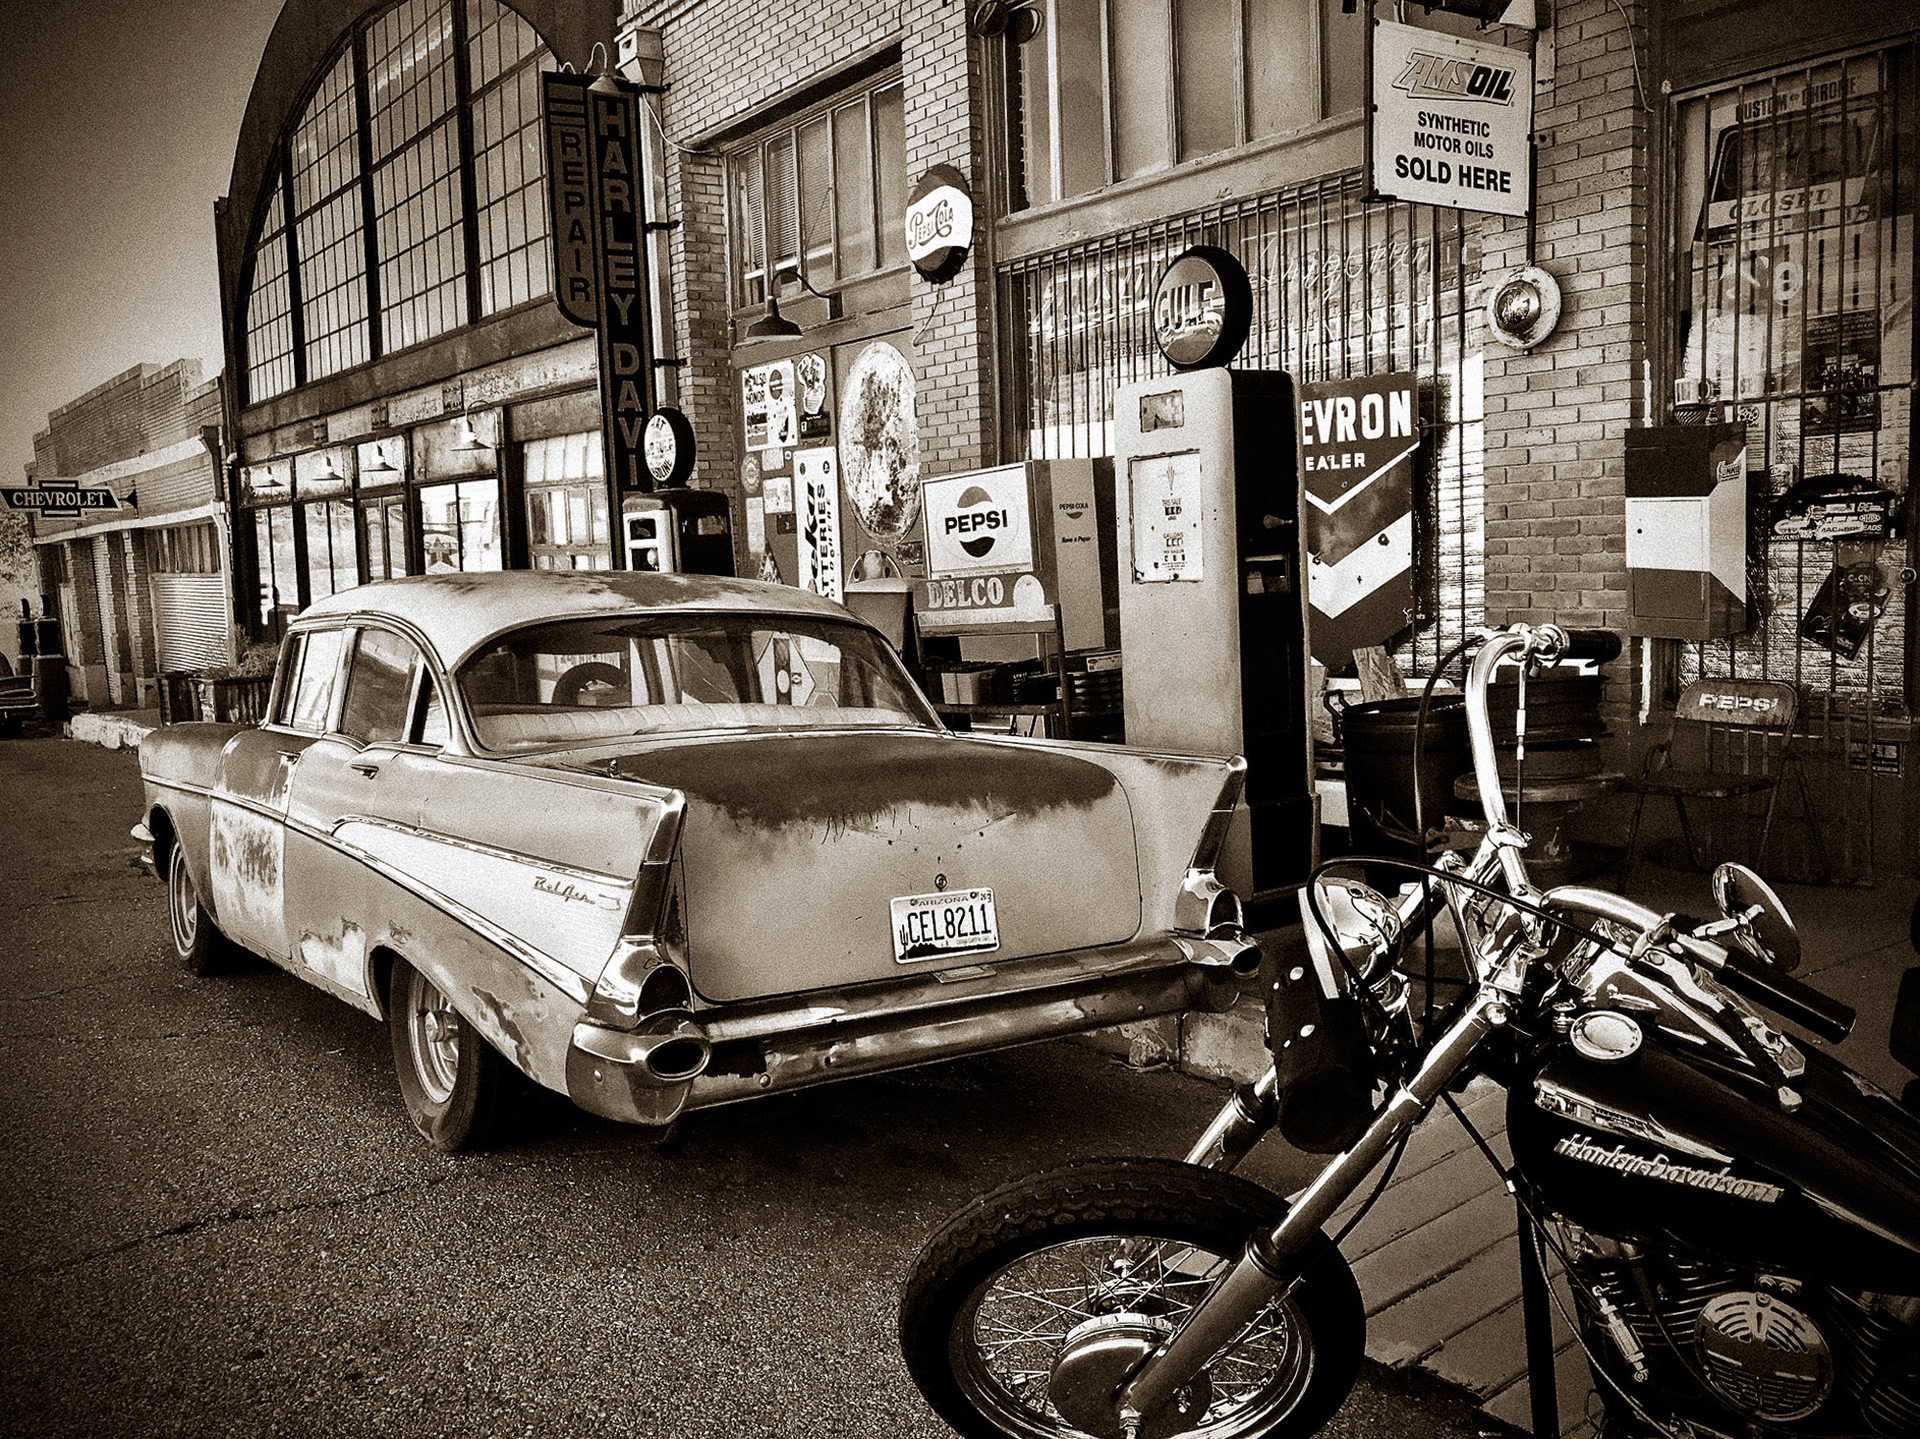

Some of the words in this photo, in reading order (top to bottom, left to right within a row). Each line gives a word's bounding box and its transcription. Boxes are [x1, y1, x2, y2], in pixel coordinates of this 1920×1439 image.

[1396, 50, 1515, 104] AMSOIL
[1802, 78, 1857, 106] CHROE
[1417, 111, 1491, 138] SYNTHETIC
[1414, 131, 1462, 154] MOTOR
[1465, 140, 1494, 159] OILS
[1395, 154, 1451, 184] SOLD
[1458, 164, 1512, 194] HERE
[560, 131, 591, 302] REPAIR
[597, 100, 637, 326] HARLEY
[1729, 188, 1834, 220] CLOSED
[612, 342, 644, 498] DAVI
[1301, 389, 1413, 446] EVRON
[1305, 453, 1366, 471] EALER
[12, 491, 107, 506] CHEVROLET
[945, 509, 1008, 535] PEPSI
[816, 483, 830, 598] TTERIES
[926, 577, 1005, 609] DELCO
[1699, 693, 1779, 712] PEPSI
[919, 896, 969, 906] ARIZONA
[907, 903, 992, 944] CEL8211
